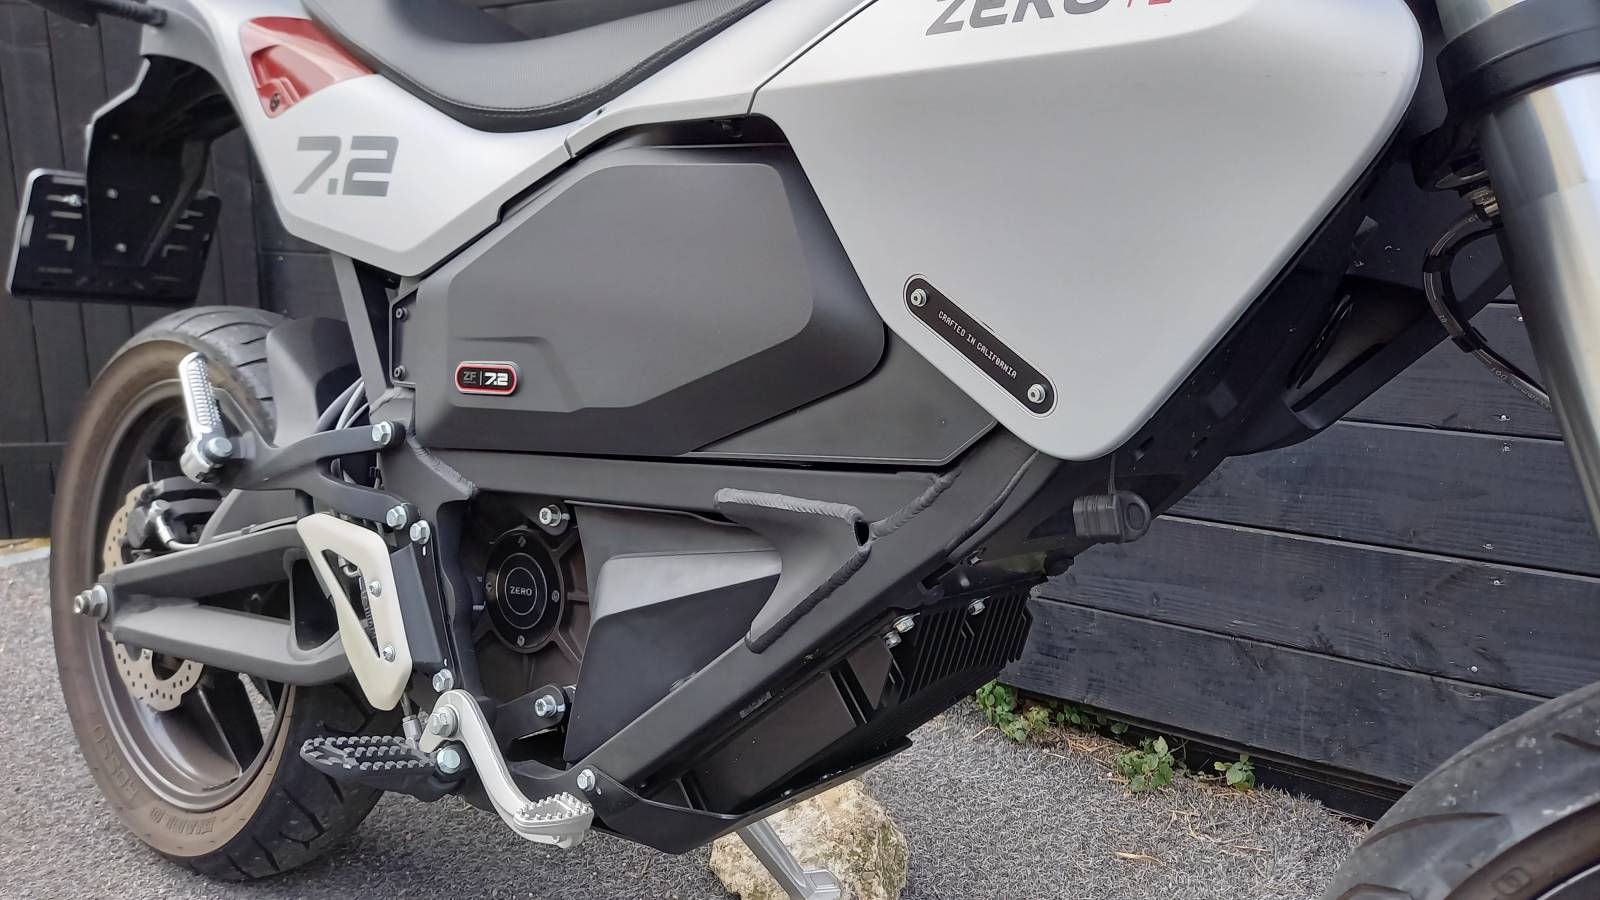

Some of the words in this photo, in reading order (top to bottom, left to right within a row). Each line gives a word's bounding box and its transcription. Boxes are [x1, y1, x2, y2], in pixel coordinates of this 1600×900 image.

[293, 136, 399, 197] 7.2
[938, 310, 966, 337] CRAFTED
[966, 333, 976, 346] IN
[976, 342, 1017, 379] CALIFORNIA
[463, 371, 477, 381] ZF
[484, 372, 508, 386] 7.2
[509, 586, 533, 597] ZERO
